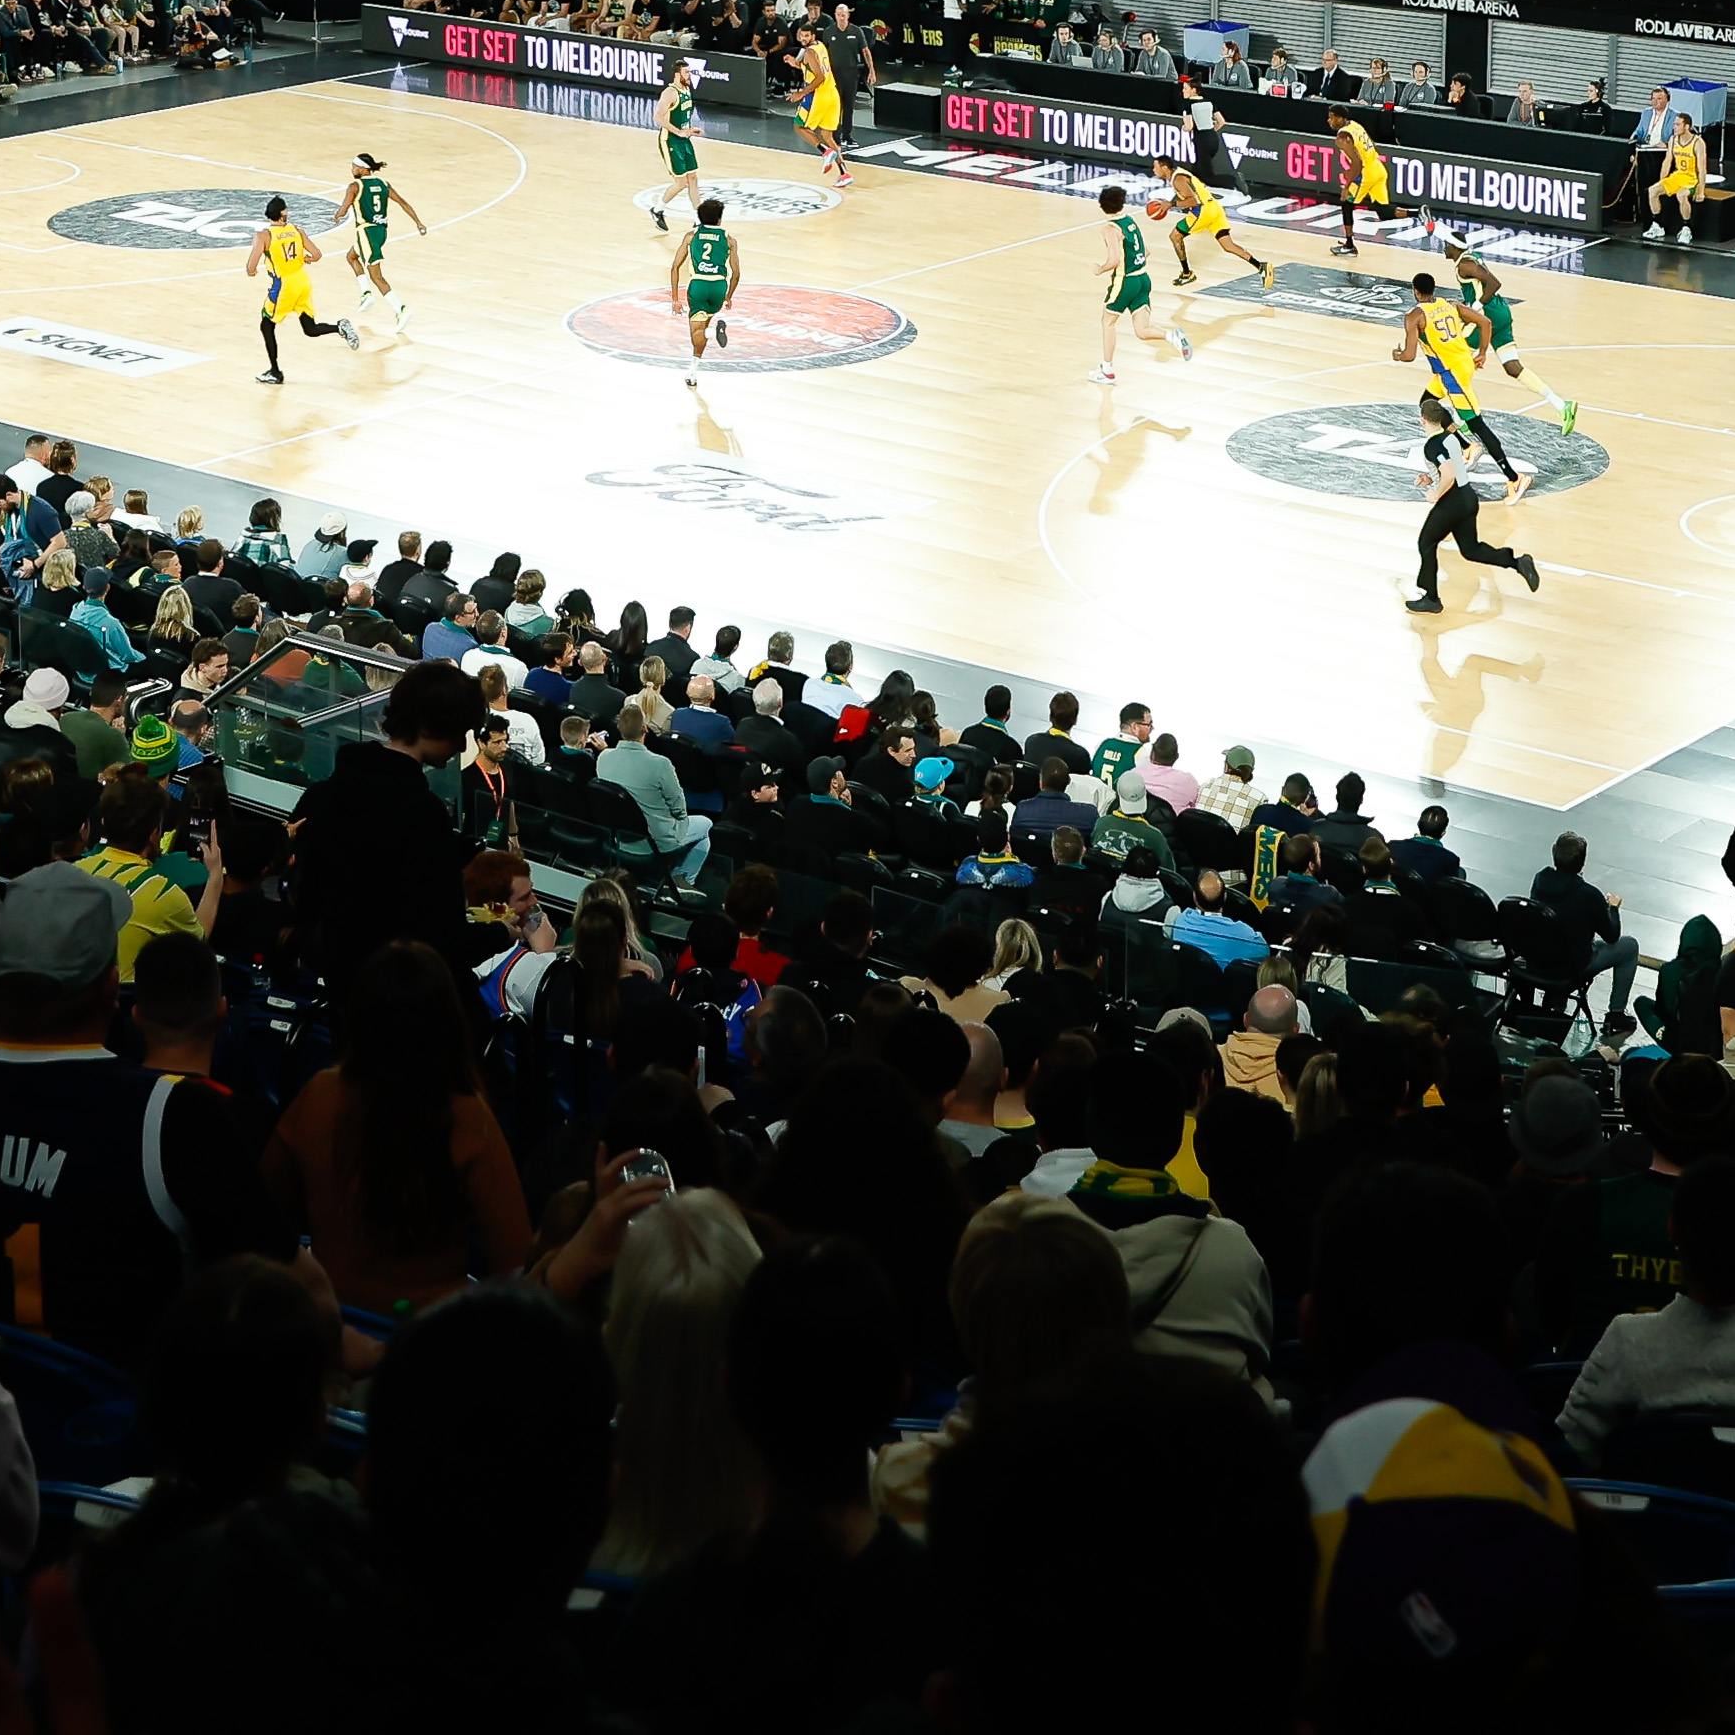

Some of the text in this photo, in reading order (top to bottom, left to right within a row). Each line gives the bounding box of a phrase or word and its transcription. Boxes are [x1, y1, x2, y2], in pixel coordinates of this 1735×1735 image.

[445, 24, 664, 86] GET SET TO MELBOURNE
[947, 94, 1197, 164] GET SET TO MELBOURN
[1680, 159, 1689, 173] 9
[1286, 142, 1334, 183] GET
[1392, 156, 1424, 196] TO
[1430, 162, 1587, 221] MELBOURNE
[372, 195, 382, 213] 5
[109, 200, 271, 239] TAC
[283, 241, 297, 263] 14
[702, 243, 713, 261] 2
[1434, 316, 1457, 343] 50
[39, 333, 163, 365] SIGNET
[1100, 763, 1115, 791] 5
